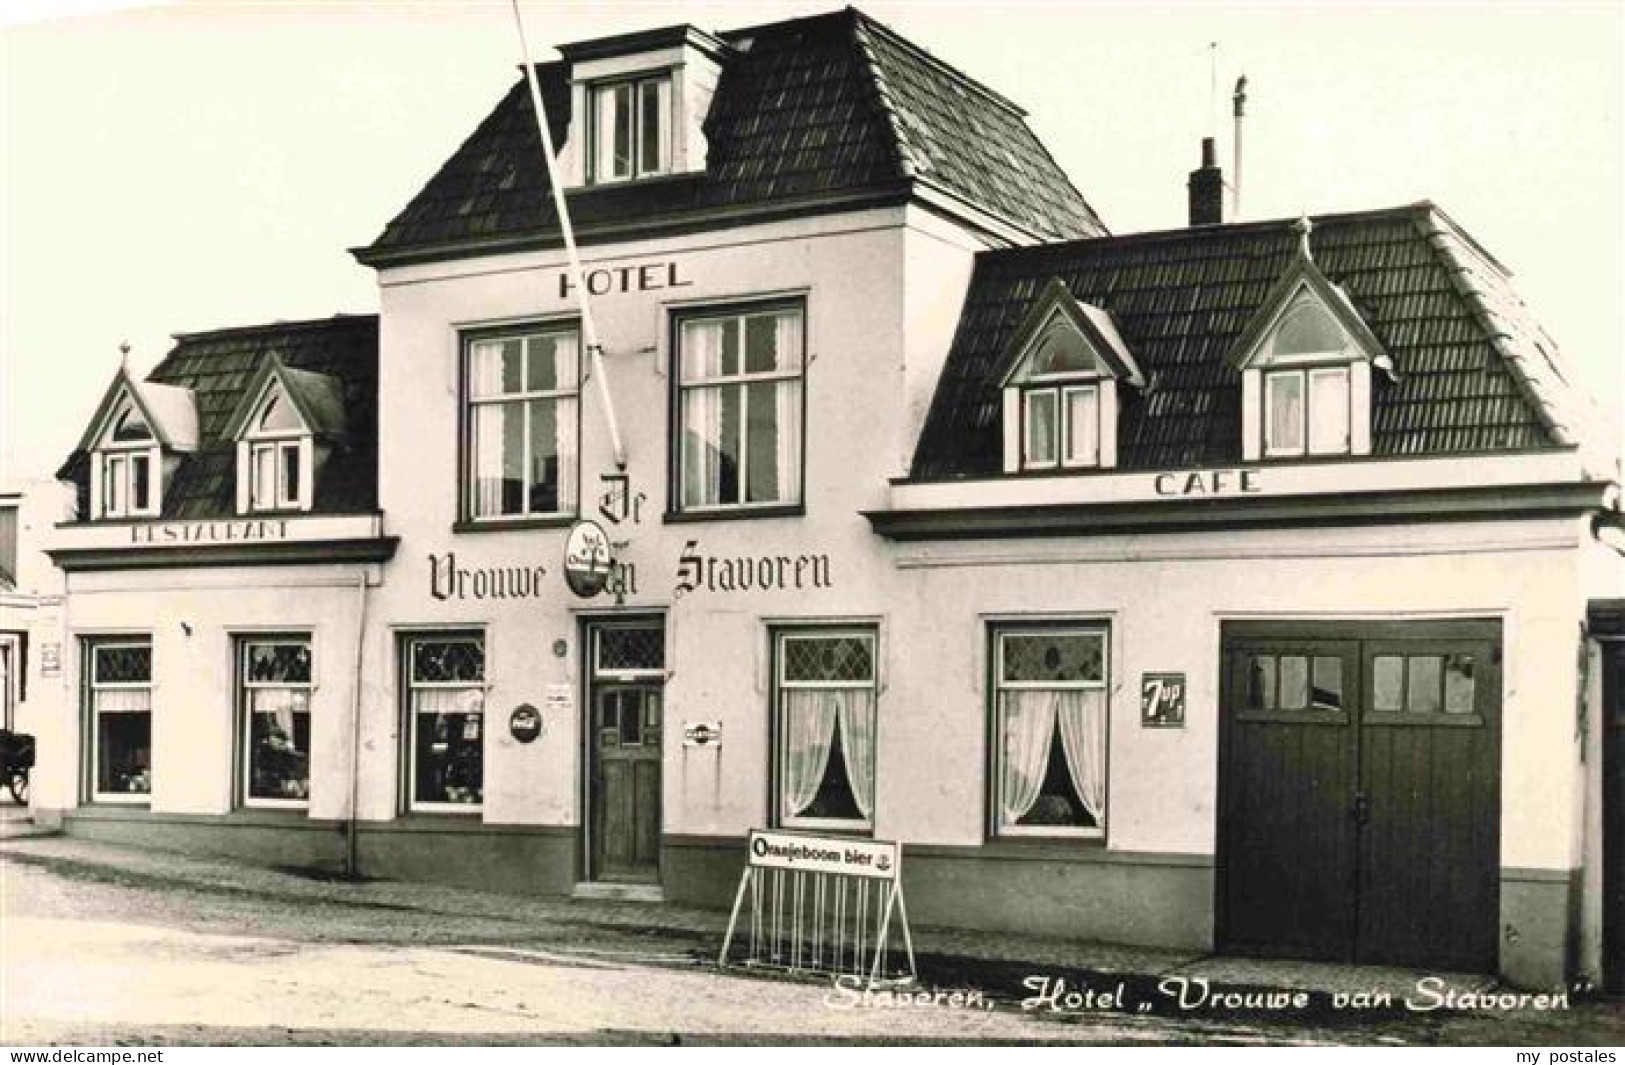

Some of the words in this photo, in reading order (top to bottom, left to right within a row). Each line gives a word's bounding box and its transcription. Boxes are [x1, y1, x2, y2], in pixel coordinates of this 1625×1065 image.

[559, 262, 694, 298] HOTEL
[1154, 470, 1261, 494] CAFE
[131, 521, 286, 543] RESTAURANT
[428, 552, 547, 600] Vrouwe
[674, 540, 832, 598] Stavoren
[844, 848, 873, 866] bier
